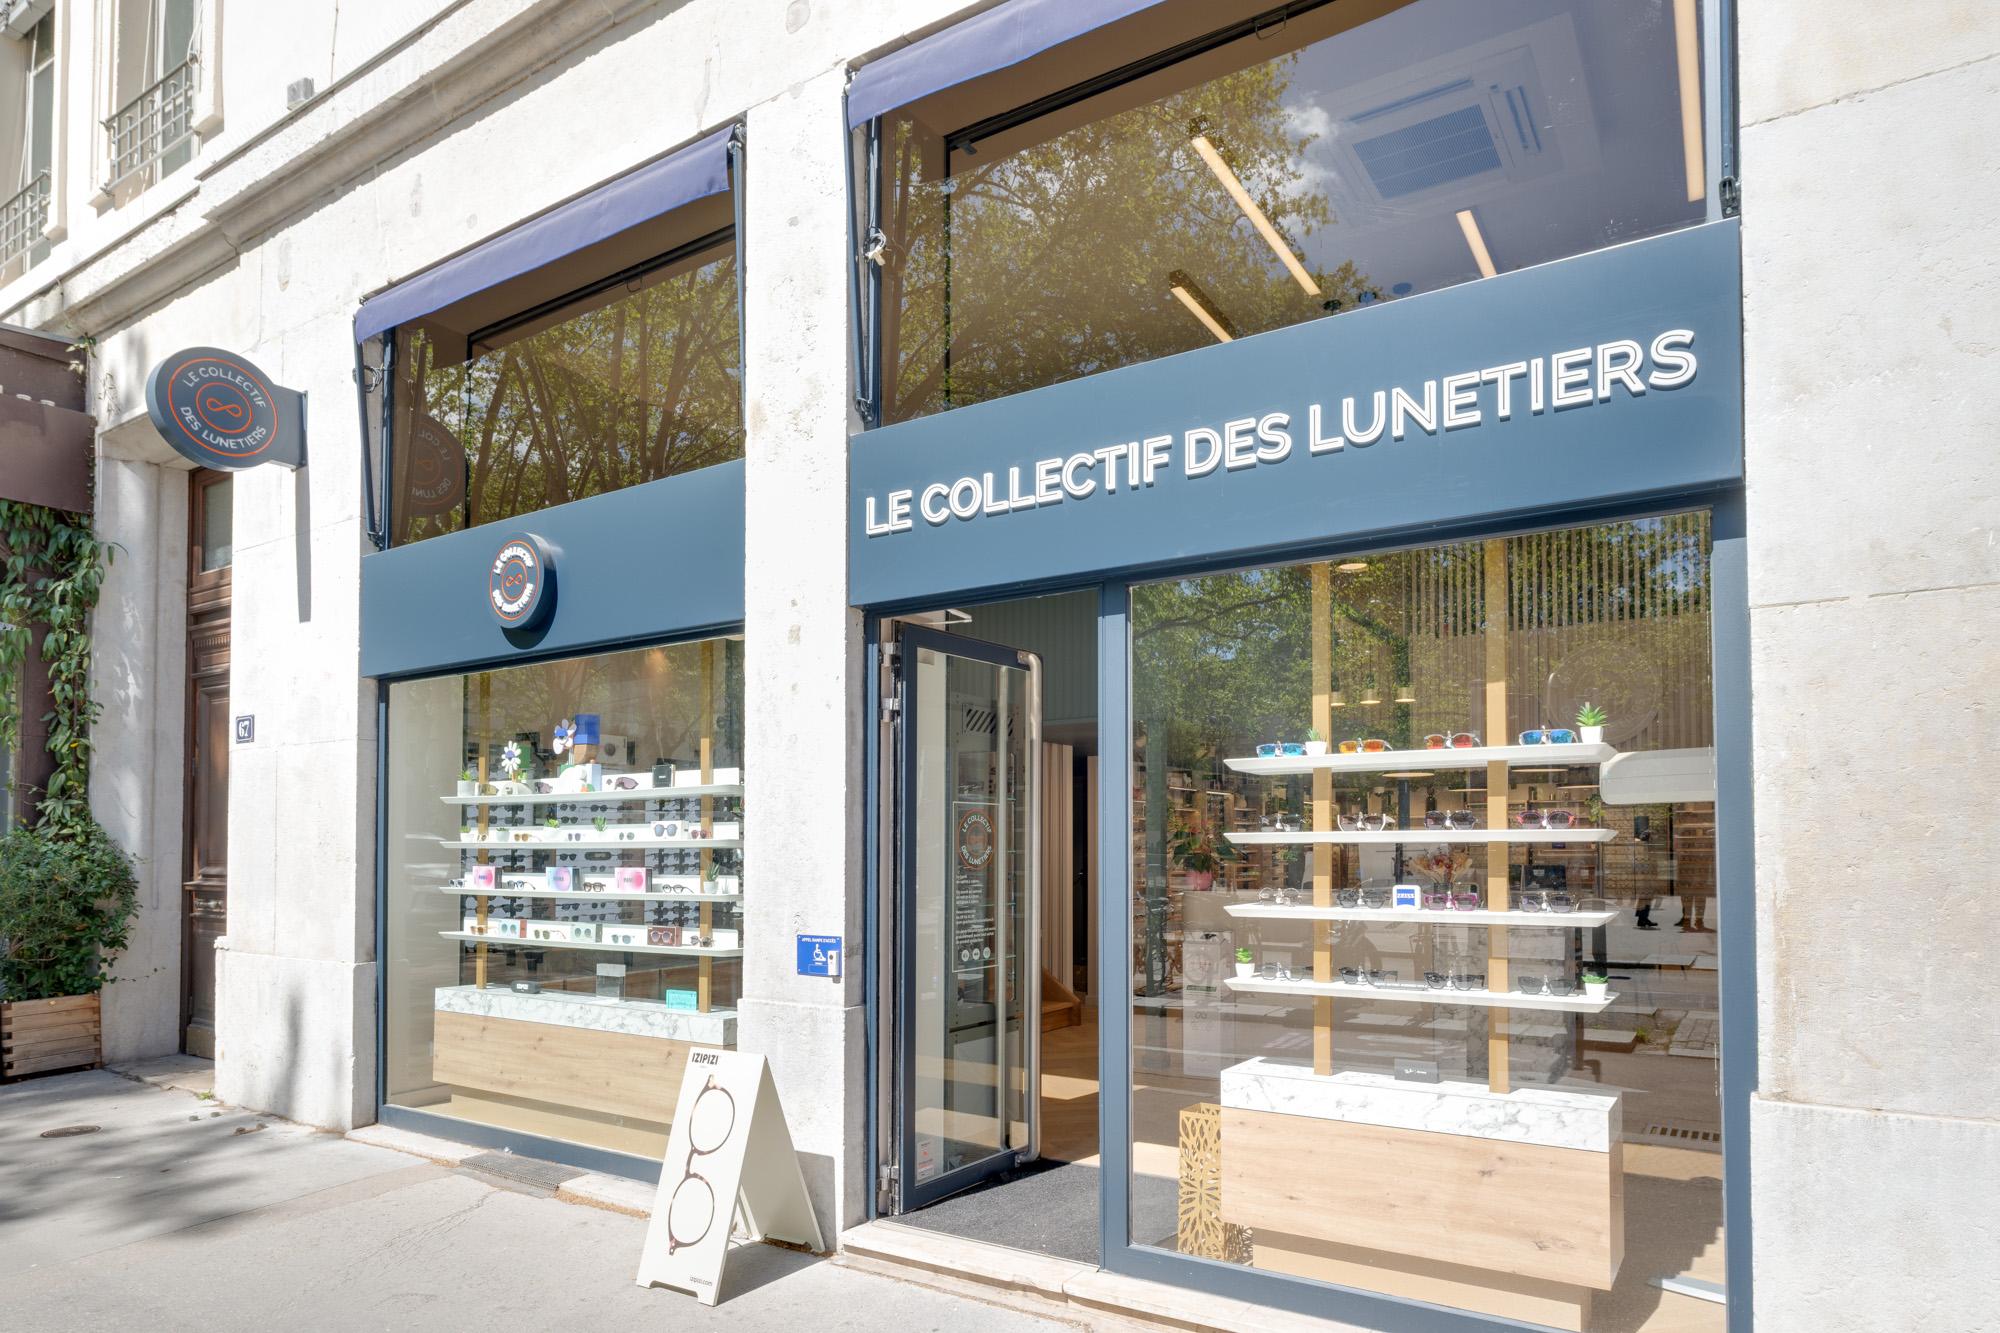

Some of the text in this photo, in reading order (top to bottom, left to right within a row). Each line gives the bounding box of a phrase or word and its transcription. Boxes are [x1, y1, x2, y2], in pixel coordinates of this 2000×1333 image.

[183, 366, 266, 409] LE COLLECTIF
[180, 406, 267, 449] DES LUNETIERS
[865, 329, 1698, 536] LE COLLECTIF DES LUNETIERS
[238, 720, 250, 738] 67
[962, 814, 992, 833] LE COLLECTIF
[961, 845, 993, 865] DES LUNETIERS
[691, 1052, 719, 1065] IZIPIZI
